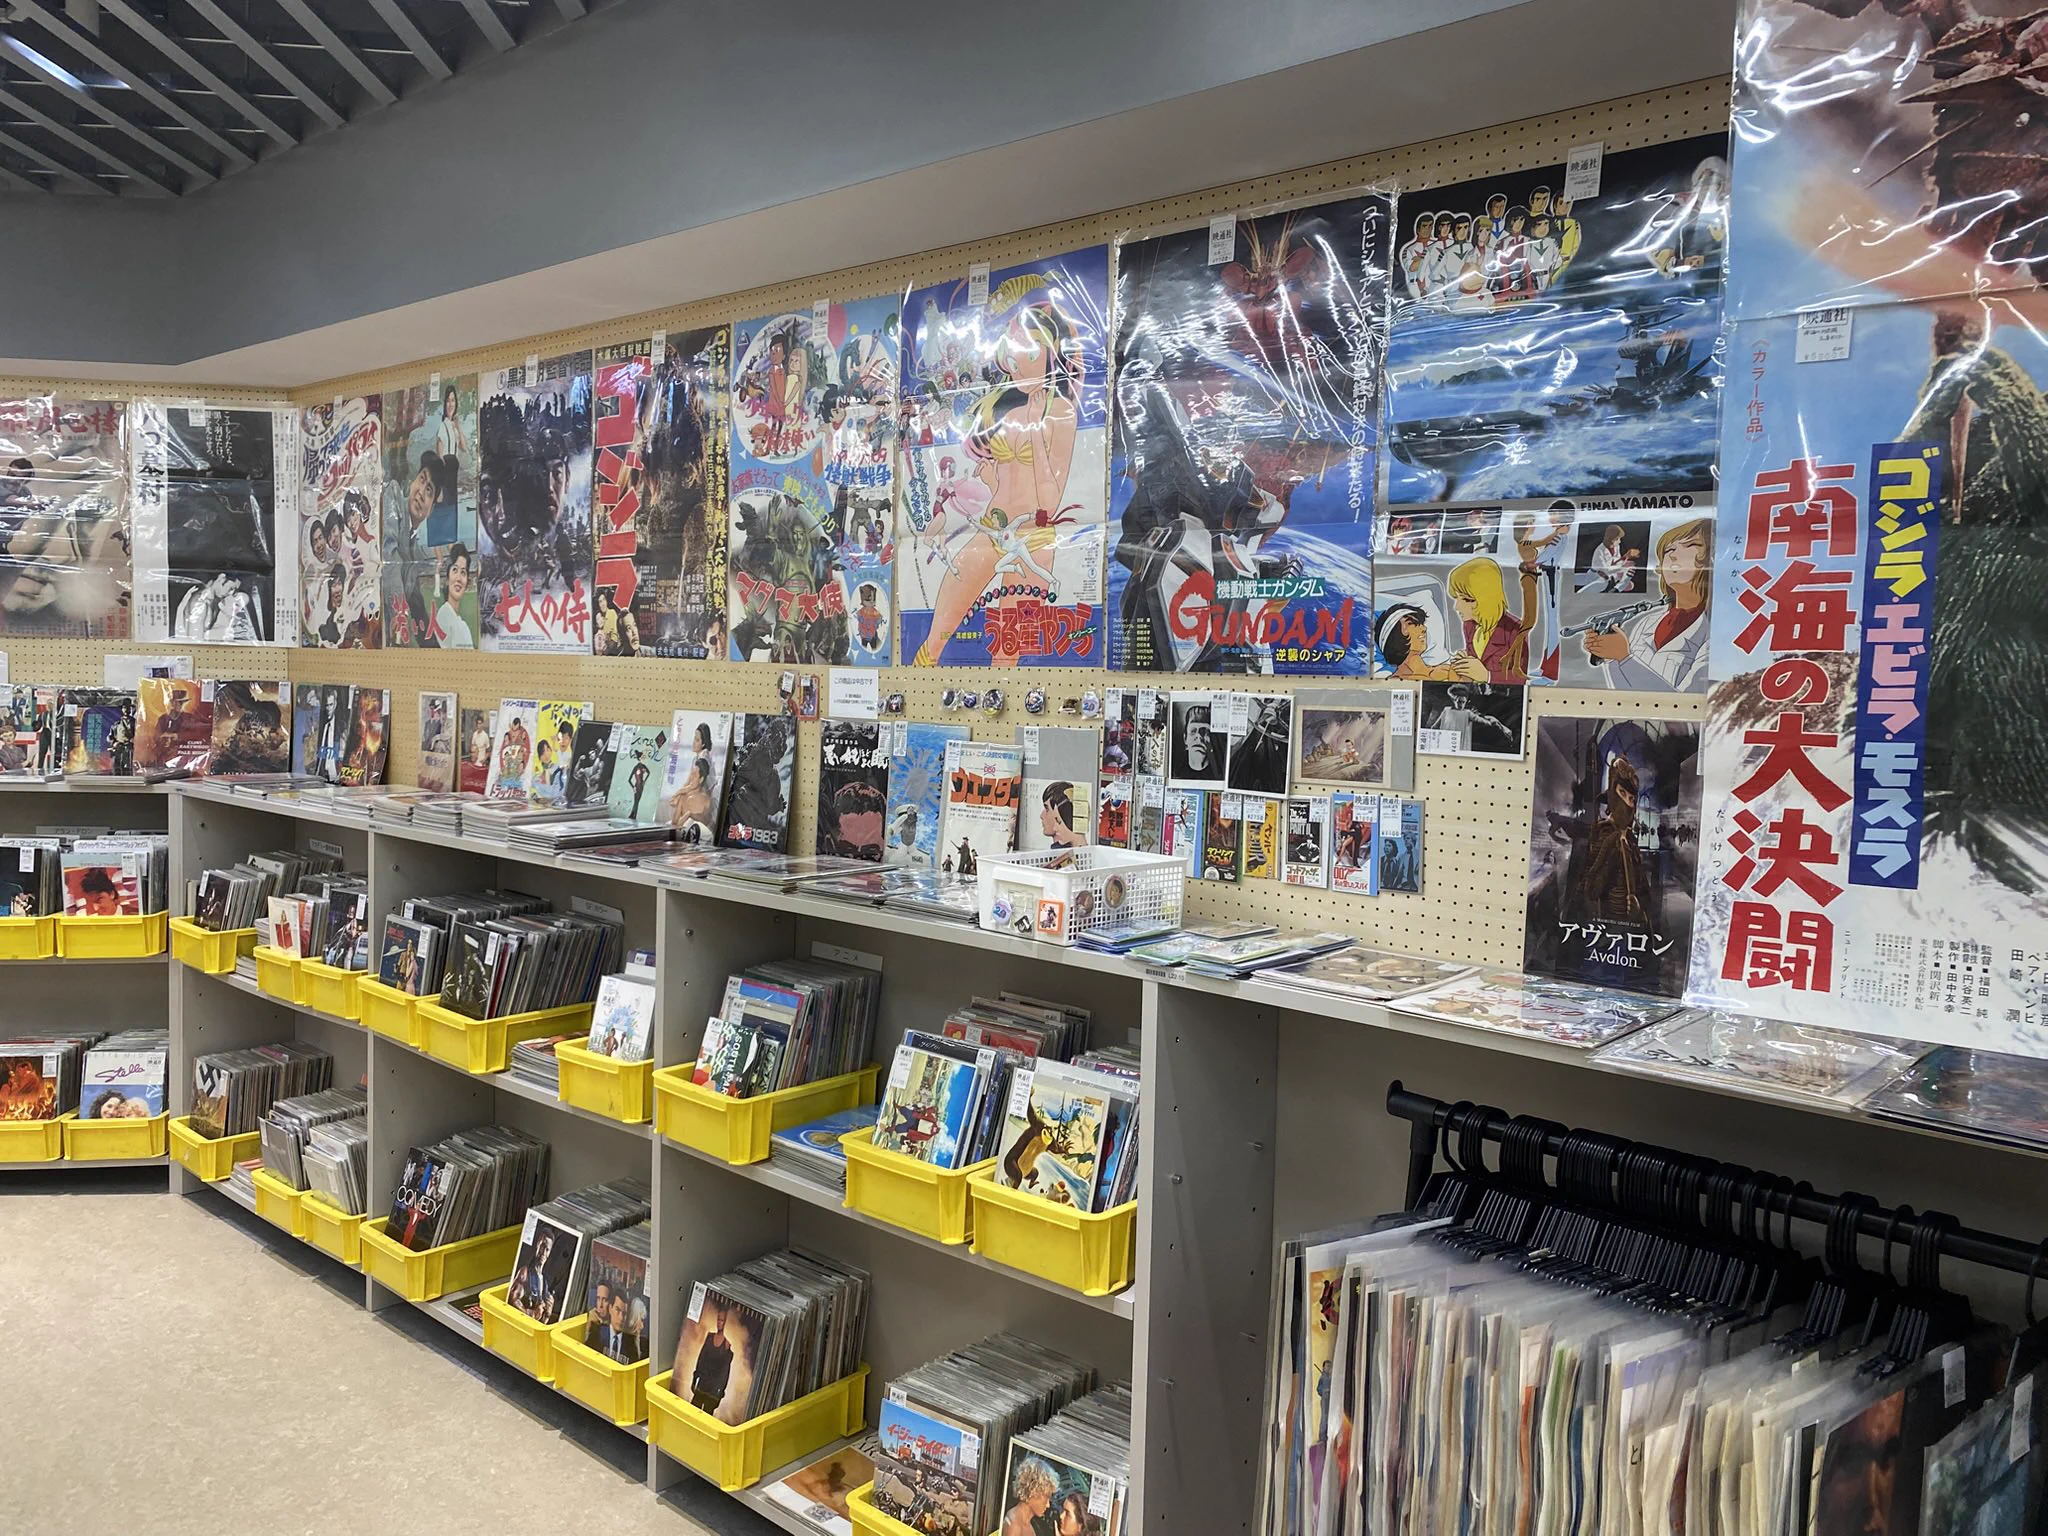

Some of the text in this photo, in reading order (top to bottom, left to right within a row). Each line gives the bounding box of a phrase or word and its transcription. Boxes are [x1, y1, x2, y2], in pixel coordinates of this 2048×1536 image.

[1571, 158, 1597, 171] 映通社
[1213, 229, 1232, 240] 映通社
[594, 354, 652, 611] ゴジラ
[824, 463, 892, 487] 怪獣戦争
[1580, 495, 1694, 511] FINAL YAMATO
[1730, 535, 1743, 596] なんかい
[736, 571, 847, 623] マグマ大使
[1216, 580, 1324, 599] 機動戦士ガンダム
[392, 592, 447, 644] 若い人
[496, 578, 590, 643] 七人の侍
[1169, 570, 1355, 648] GUNDAM
[984, 600, 1095, 657] うる星やつら
[1275, 648, 1345, 663] 逆襲のシャア
[1720, 458, 1858, 993] 南海の大決闘
[1247, 821, 1267, 867] EN-HUR
[1287, 874, 1300, 884] PART
[831, 948, 859, 963] アニメ
[1559, 921, 1675, 956] アヴァロン
[1586, 949, 1640, 968] Avalon
[1944, 972, 1958, 1013] 田中友幸
[95, 1063, 146, 1083] Stella
